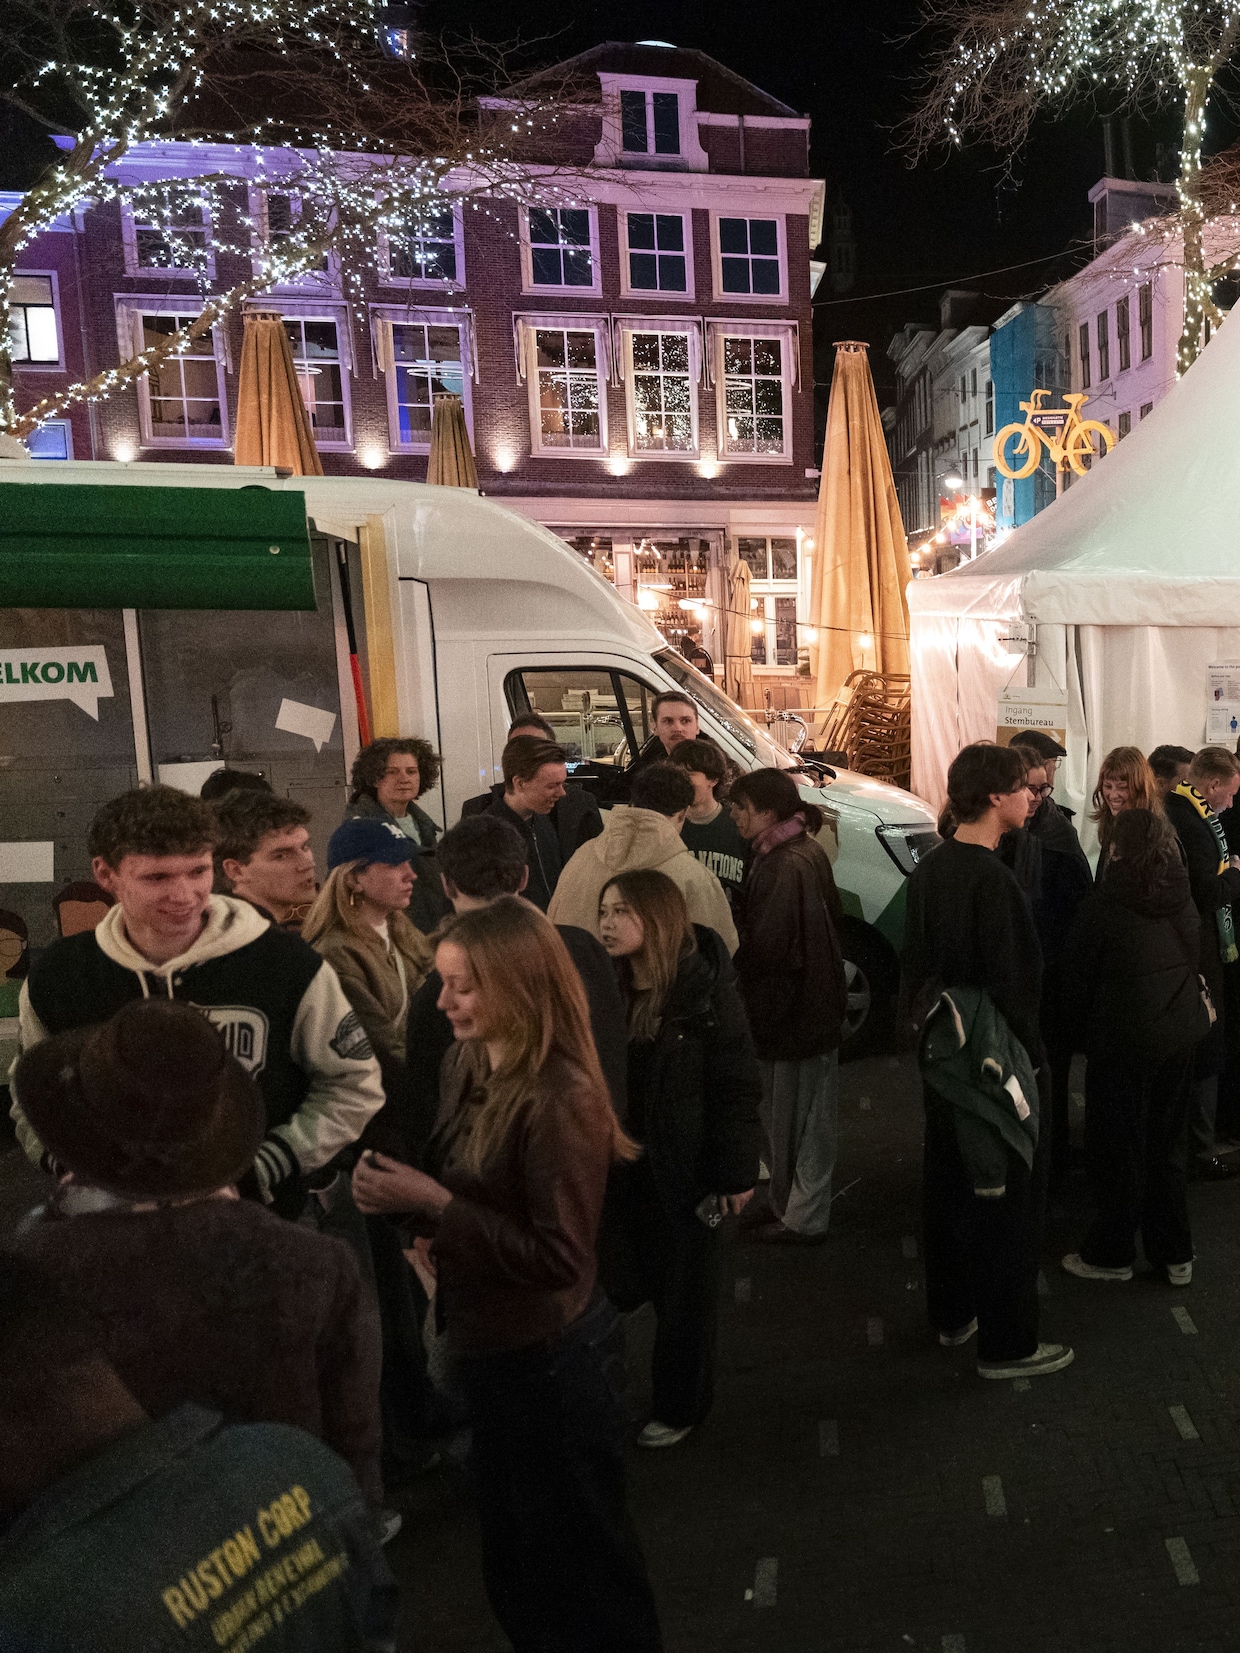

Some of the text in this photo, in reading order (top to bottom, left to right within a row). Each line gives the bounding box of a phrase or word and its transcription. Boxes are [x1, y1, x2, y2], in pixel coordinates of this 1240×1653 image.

[0, 661, 99, 684] LKOM
[1005, 706, 1033, 717] Ingang
[1004, 716, 1054, 726] Stembureau
[161, 1523, 260, 1628] RUSTON
[257, 1484, 312, 1548] CORP
